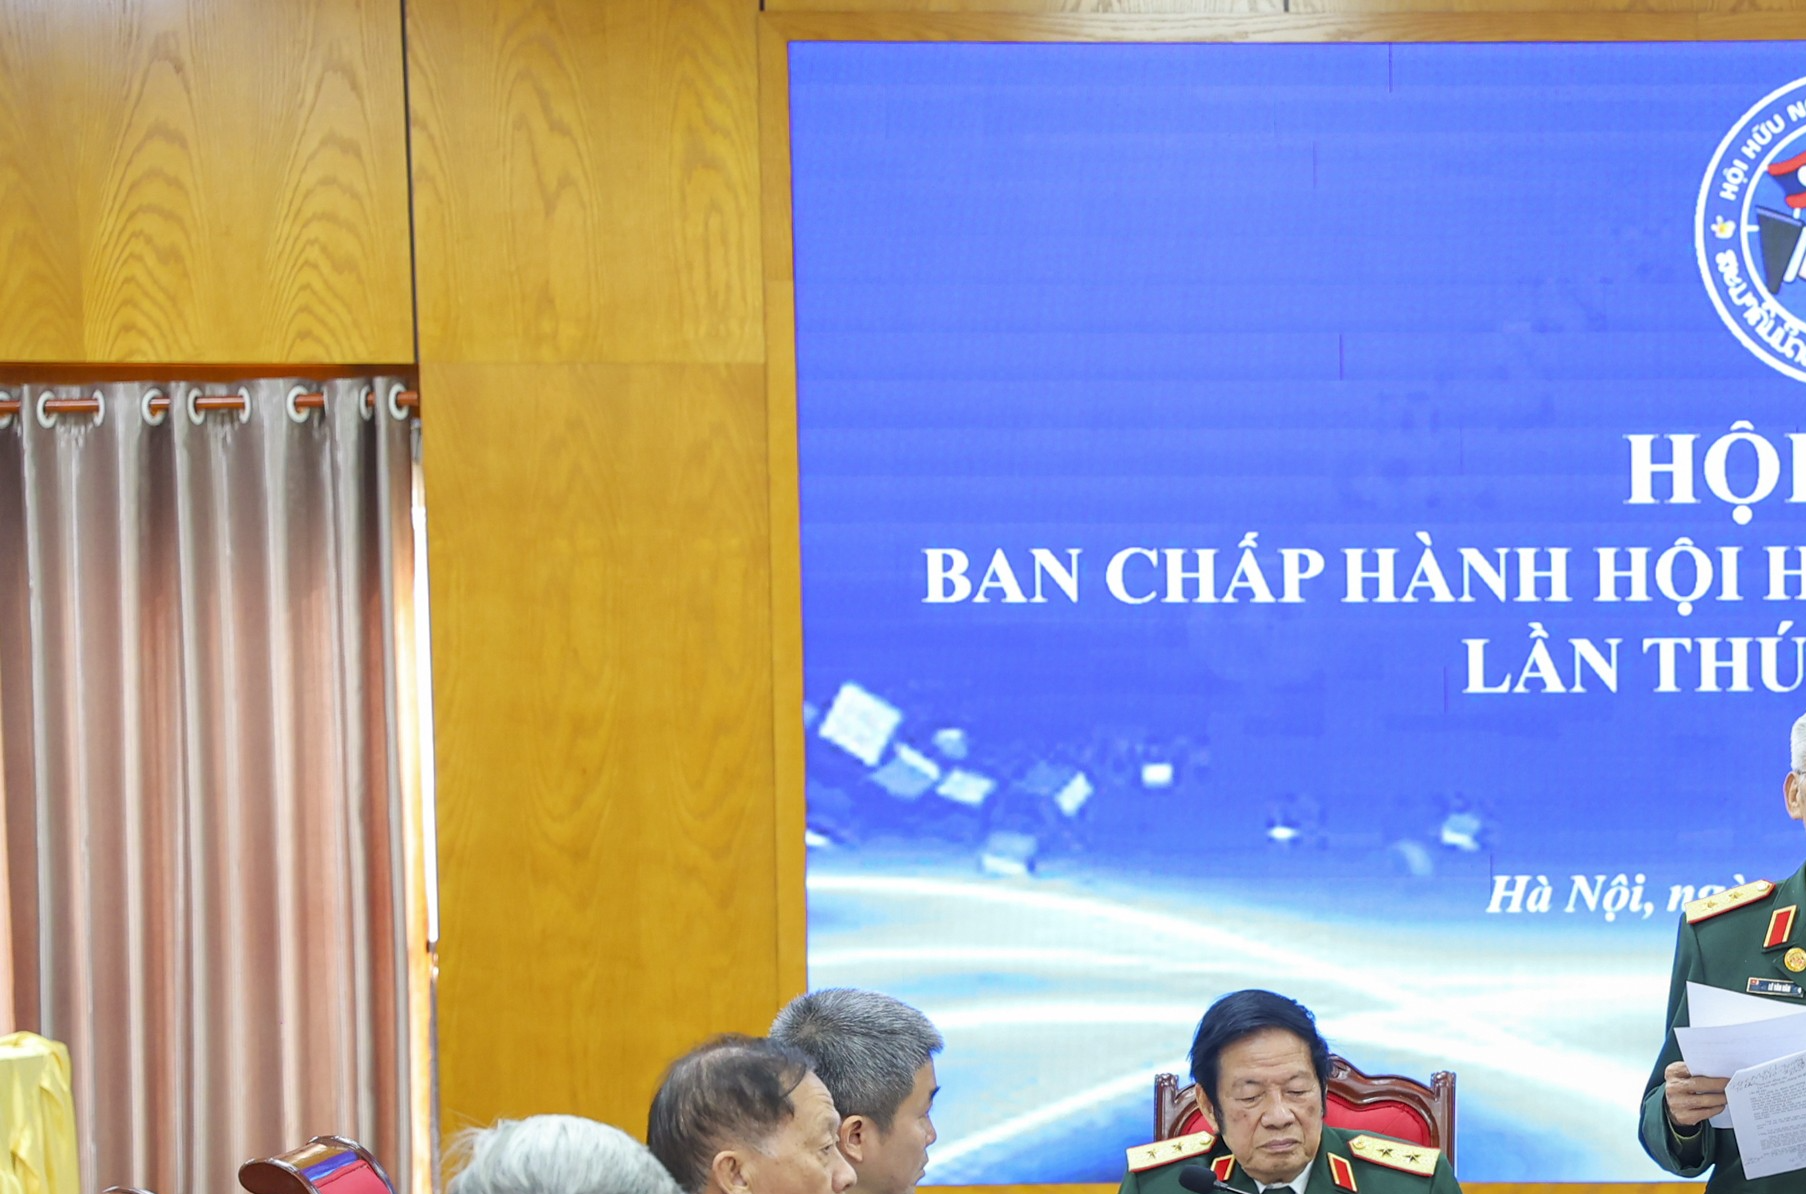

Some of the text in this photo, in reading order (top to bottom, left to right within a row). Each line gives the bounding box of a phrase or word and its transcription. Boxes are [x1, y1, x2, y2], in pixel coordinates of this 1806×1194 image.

[1719, 158, 1750, 201] HỘI
[1741, 113, 1786, 160] HỮU
[922, 548, 1082, 604] BAN
[1105, 532, 1325, 604] CHẤP
[1341, 532, 1572, 604] HÀNH
[1594, 537, 1742, 617] HỘI
[1462, 622, 1622, 695] LẦN
[1485, 873, 1553, 914] Hà
[1562, 873, 1655, 922] Nội,
